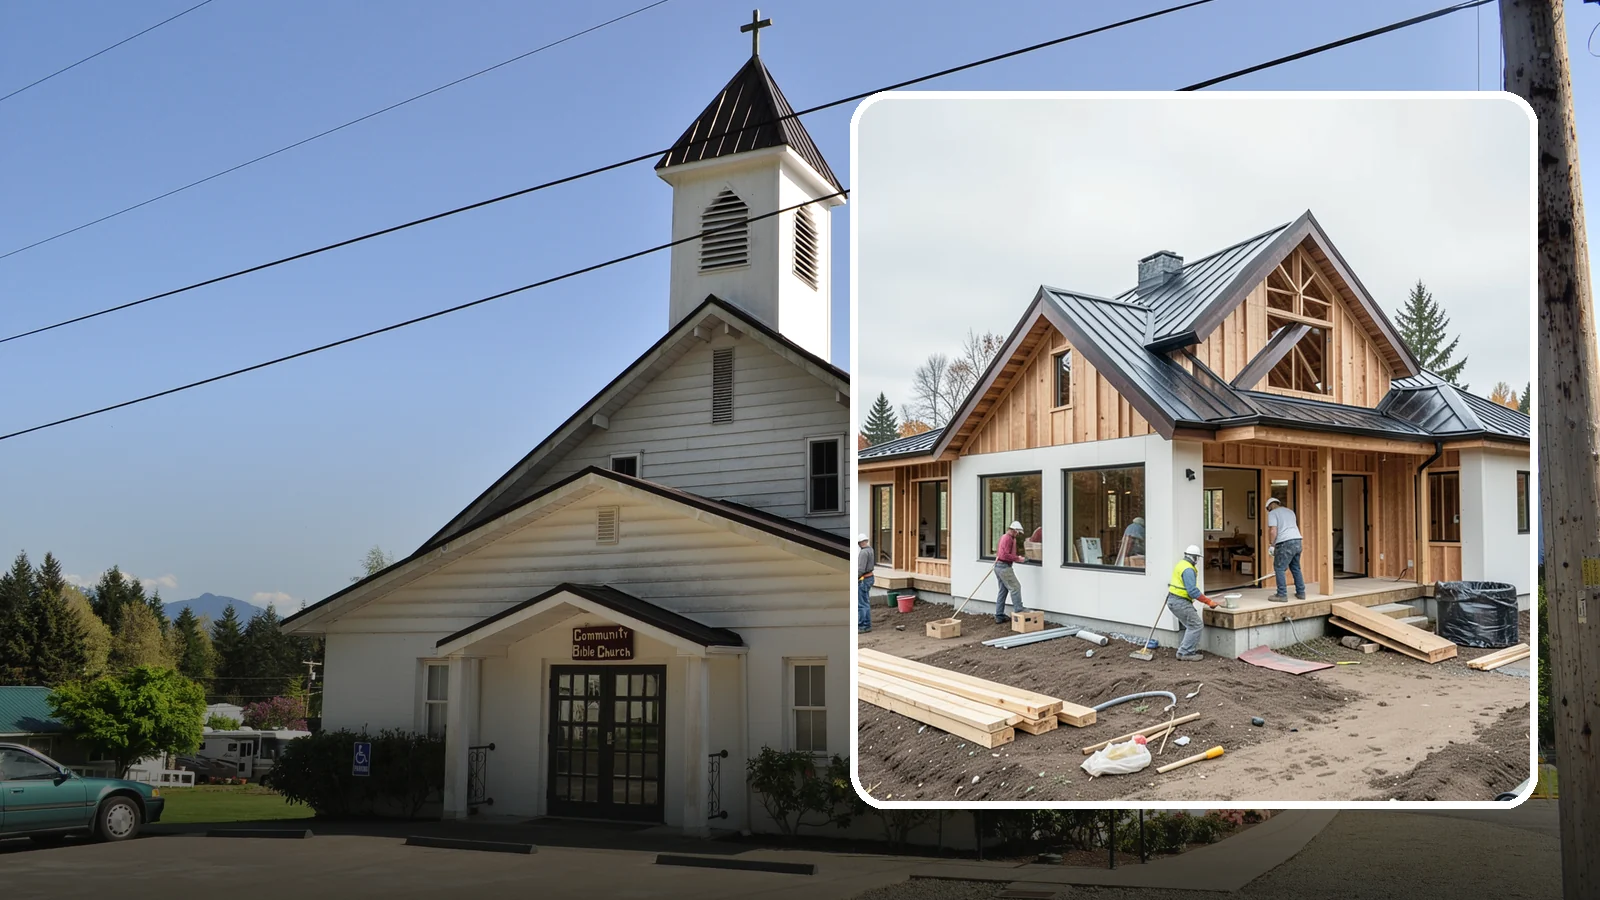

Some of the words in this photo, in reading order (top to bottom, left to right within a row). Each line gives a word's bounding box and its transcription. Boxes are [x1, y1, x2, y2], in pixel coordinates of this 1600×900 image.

[574, 627, 628, 641] Community
[572, 645, 595, 657] Bible
[597, 645, 631, 658] Church
